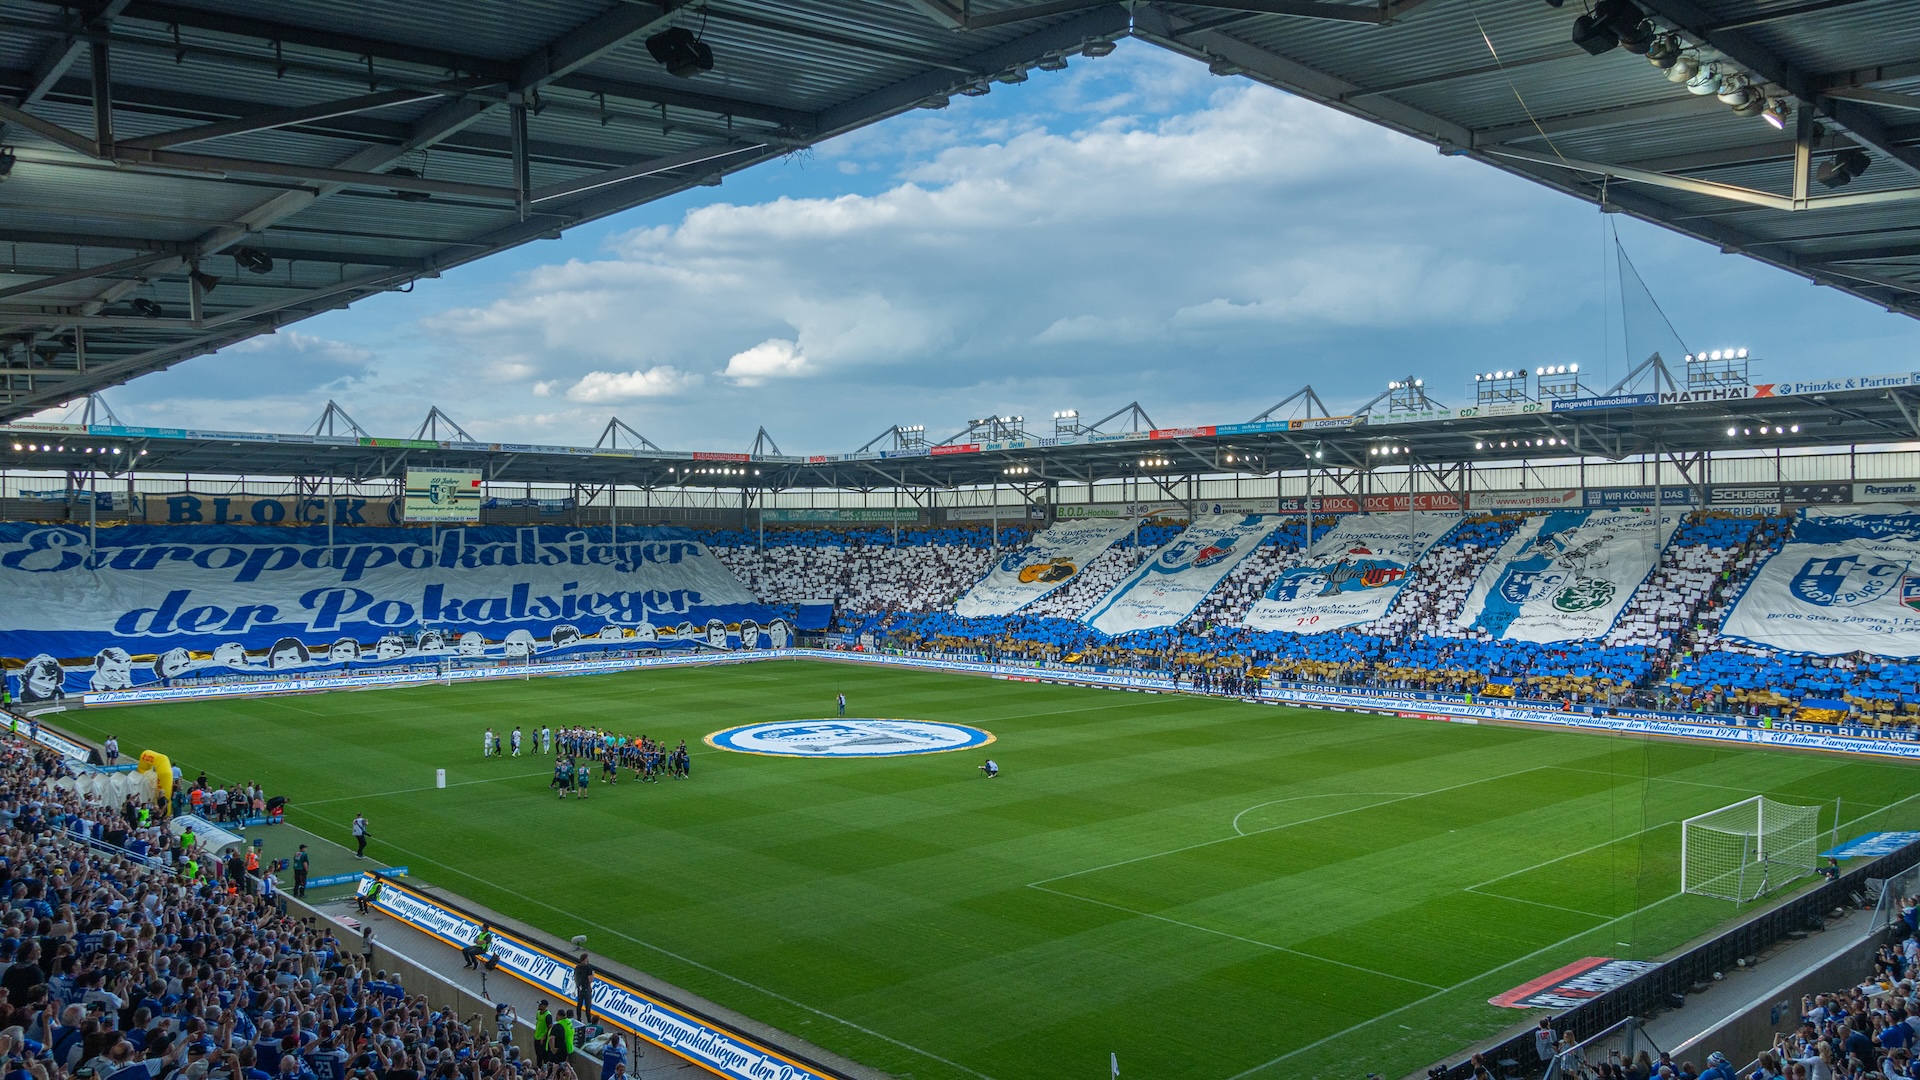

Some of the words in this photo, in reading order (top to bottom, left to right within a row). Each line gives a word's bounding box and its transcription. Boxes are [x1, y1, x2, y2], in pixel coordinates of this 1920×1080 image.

[1796, 381, 1841, 393] Prinzke
[1845, 379, 1856, 388] &
[1860, 377, 1909, 388] Partner
[1661, 388, 1748, 403] MATTHÄI
[1554, 401, 1593, 410] Aengevelt
[1594, 397, 1638, 406] Immobilien
[1315, 418, 1353, 427] LOGISTICS
[1038, 438, 1059, 447] FEGERT
[1604, 492, 1622, 500] WIR
[1624, 490, 1661, 500] KÖNNE
[1663, 490, 1684, 498] DAS
[1712, 488, 1780, 500] SCHUBERT
[1864, 484, 1916, 495] Pergande
[1323, 498, 1354, 509] MDCC
[1496, 497, 1561, 506] www.wg1893.de
[166, 496, 366, 524] BLOCK
[861, 510, 892, 518] SEGUIN
[2, 529, 704, 583] Europapokalsieger
[114, 589, 286, 634] der
[299, 581, 705, 628] Pokalsieger
[97, 694, 110, 702] 50
[110, 692, 134, 700] Jahre
[135, 689, 204, 700] Europapokalsieger
[204, 688, 218, 696] der
[219, 686, 260, 696] Pokalsieger
[274, 682, 292, 690] 1974
[1304, 692, 1316, 700] 50
[1316, 693, 1335, 702] Jahre
[1336, 695, 1396, 709] Europapokalsieger
[1396, 699, 1410, 708] der
[1410, 702, 1450, 714] Pokalsieger
[1466, 706, 1486, 716] 1974
[1488, 699, 1504, 707] die
[1510, 711, 1522, 719] 50
[1524, 710, 1548, 721] Jahre
[1550, 713, 1624, 729] Europapokalsieger
[1627, 719, 1642, 728] der
[1644, 720, 1695, 736] Pokalsieger
[1697, 728, 1714, 736] von
[1715, 727, 1740, 738] 1974
[1771, 732, 1788, 742] 50
[1789, 732, 1819, 745] Jahre
[1821, 736, 1920, 754] Europapokalsieger
[392, 891, 454, 934] Europapokalsieger
[453, 918, 469, 938] der
[512, 954, 530, 968] von
[528, 954, 558, 980] 1974
[604, 989, 638, 1018] Jahre
[638, 1003, 749, 1070] Europapokalsieger
[749, 1056, 775, 1080] der
